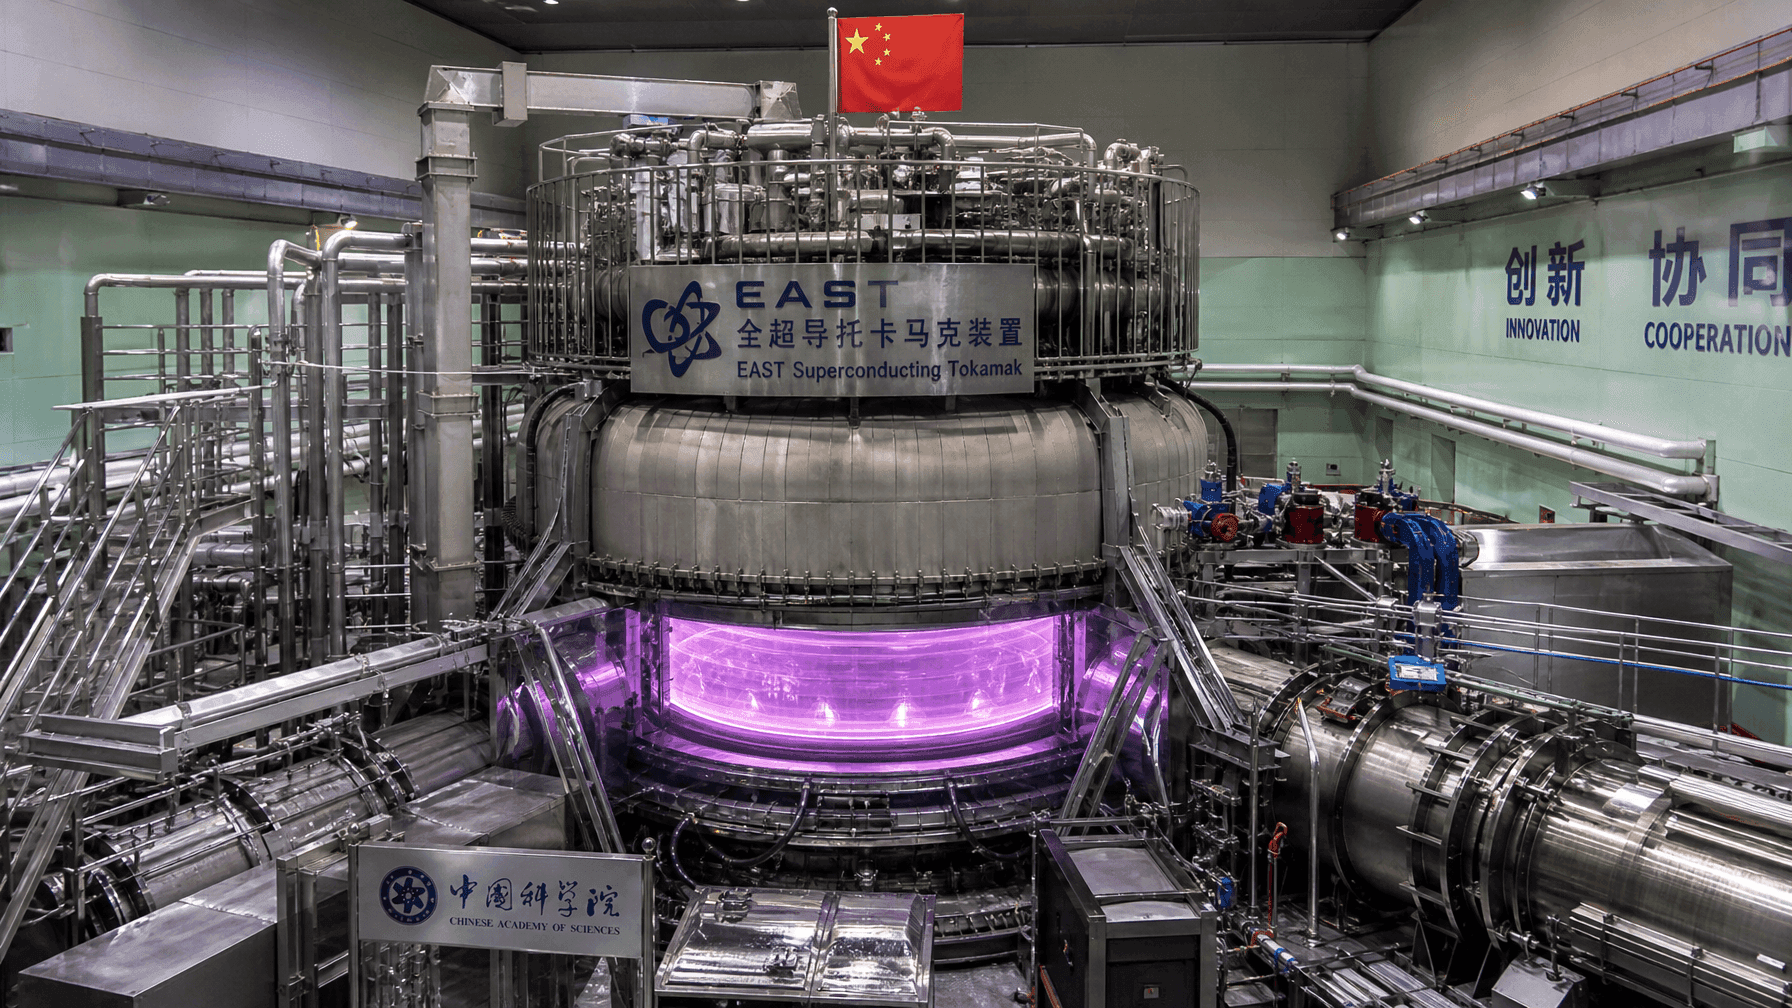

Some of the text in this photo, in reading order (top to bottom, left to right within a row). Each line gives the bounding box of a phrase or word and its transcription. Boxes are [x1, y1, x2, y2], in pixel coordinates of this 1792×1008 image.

[1505, 239, 1586, 307] 创新
[1648, 217, 1792, 307] 协同
[735, 280, 899, 309] EAST
[737, 317, 1023, 350] 全超导托卡马克装置
[1505, 317, 1581, 343] INNOVATION
[1644, 321, 1791, 357] COOPERATION
[737, 358, 1023, 384] EAST Superconducting Tokamak
[449, 916, 620, 936] CHINESE ACADEMY OF SCIENCES
